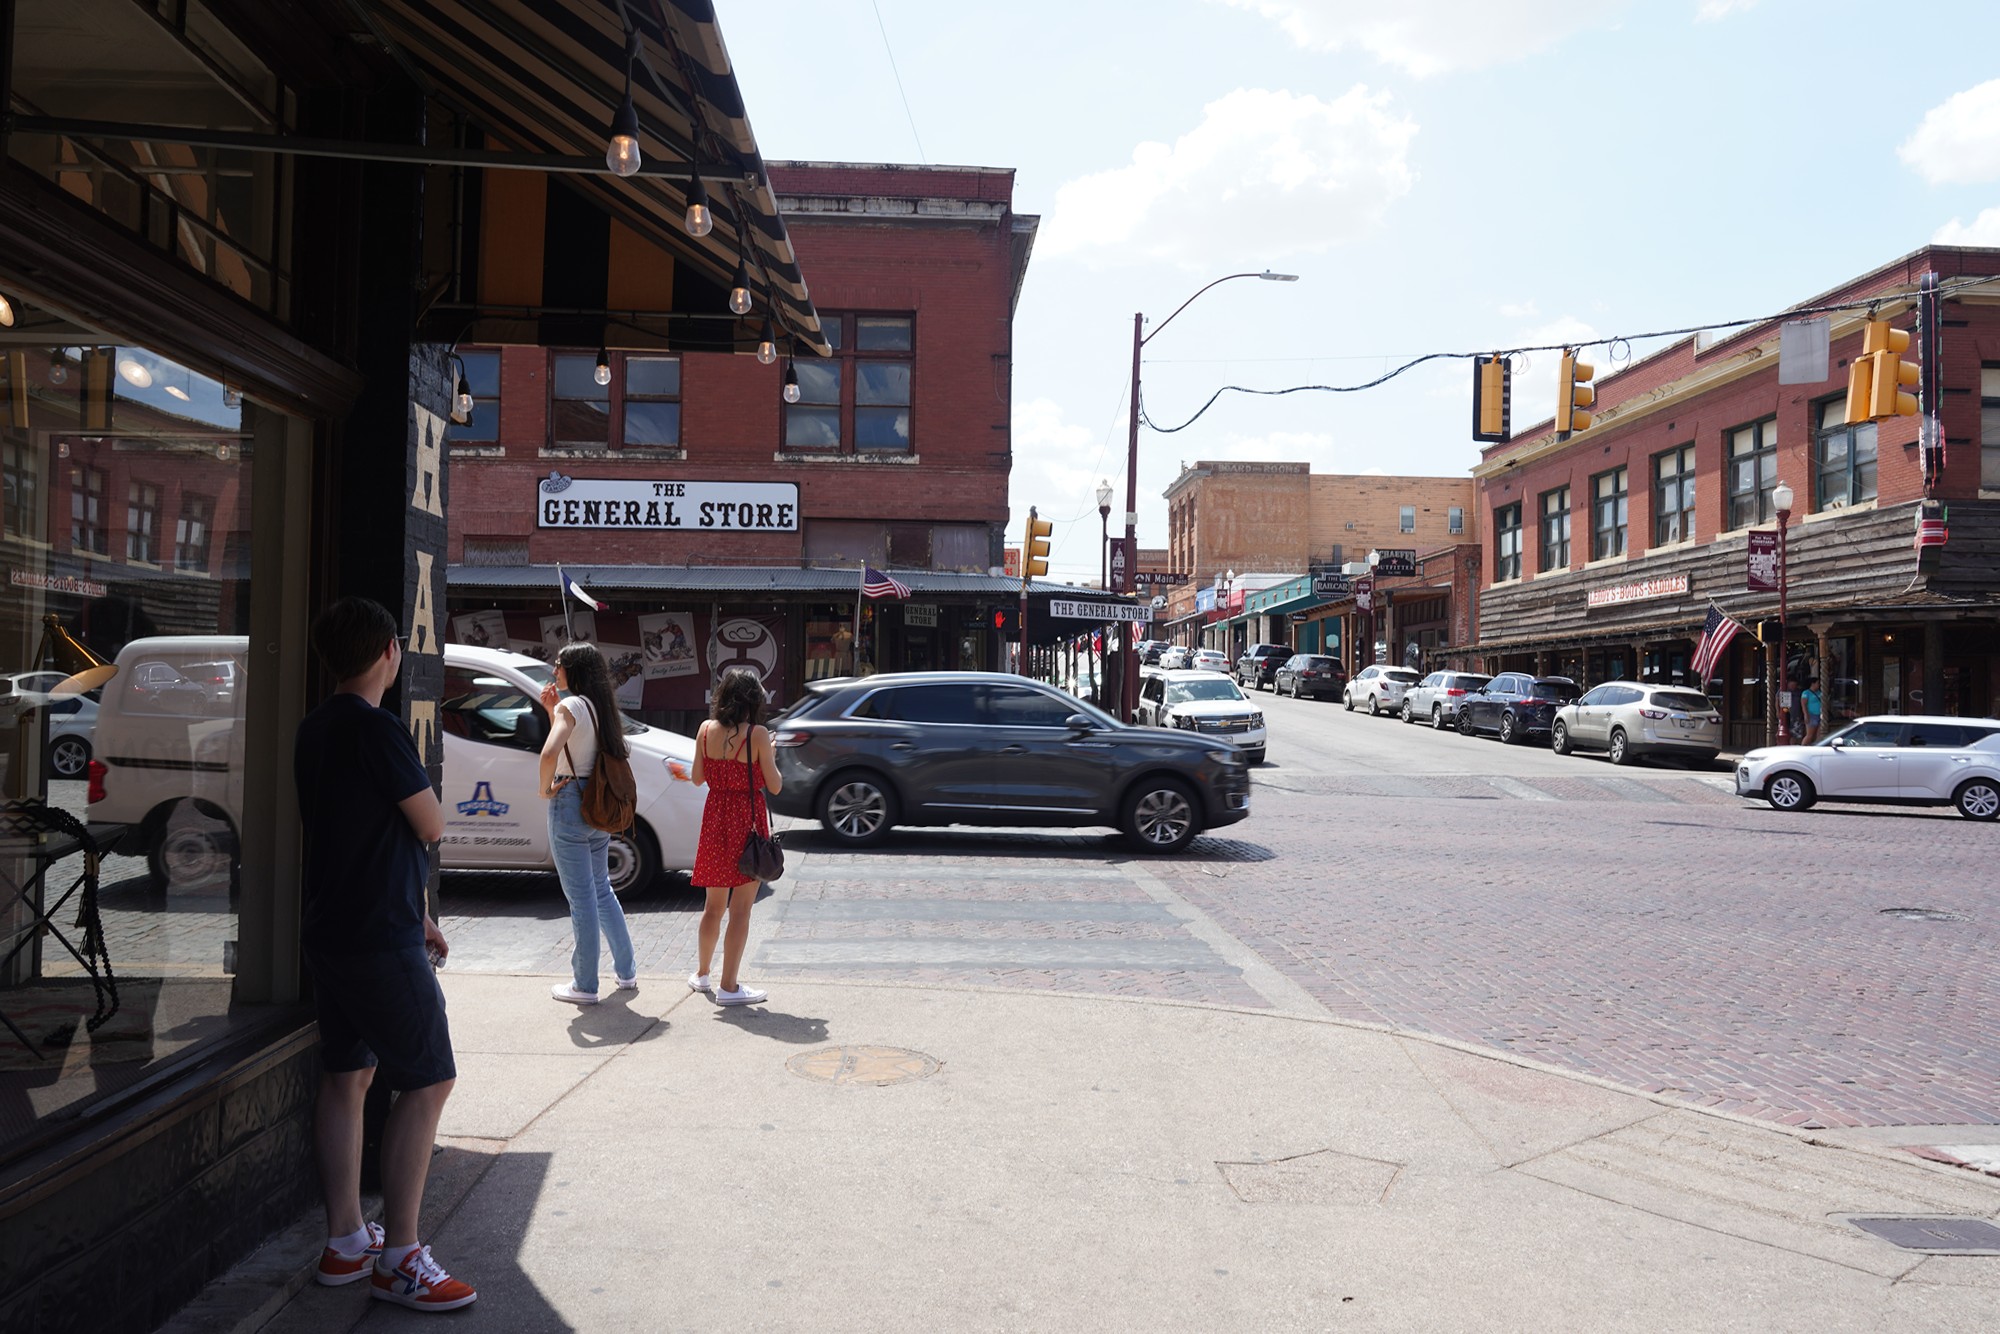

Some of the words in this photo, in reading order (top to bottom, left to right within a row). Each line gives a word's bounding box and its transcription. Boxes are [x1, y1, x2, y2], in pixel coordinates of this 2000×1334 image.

[1263, 465, 1301, 473] ROOMS
[653, 483, 686, 497] THE
[544, 499, 681, 526] GENERAL
[699, 502, 794, 528] STORE
[1145, 573, 1151, 582] N
[1154, 574, 1174, 583] Main
[1317, 582, 1348, 591] RAILCAR
[905, 606, 936, 616] GENERAL
[1054, 601, 1074, 616] THE
[1077, 603, 1118, 618] GENERAL
[1121, 606, 1149, 620] STORE
[910, 615, 932, 625] STORE
[457, 801, 508, 813] ANDREWS
